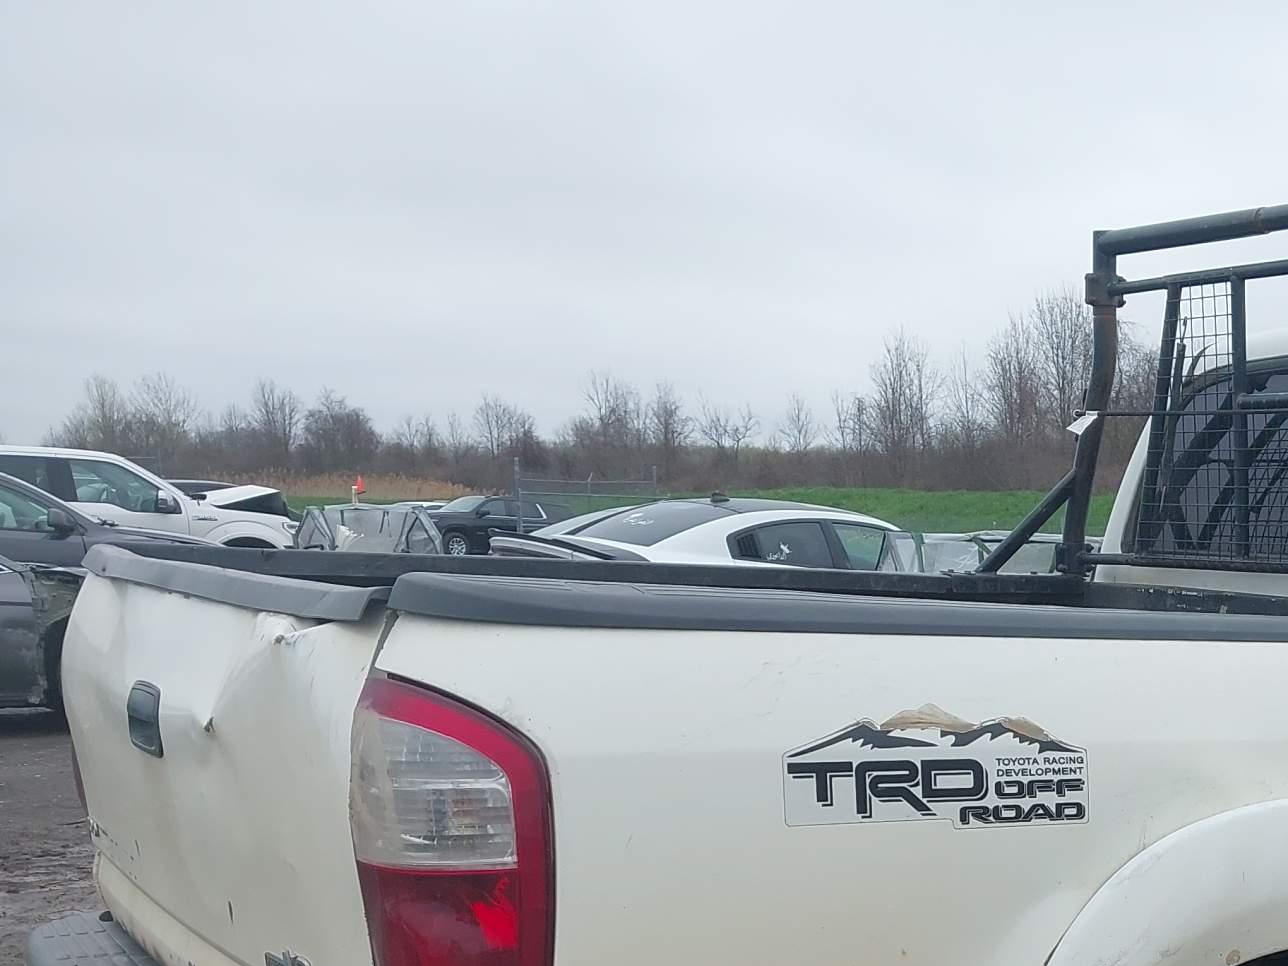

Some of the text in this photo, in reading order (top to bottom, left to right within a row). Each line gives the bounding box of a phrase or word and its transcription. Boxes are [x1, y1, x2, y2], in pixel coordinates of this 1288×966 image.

[995, 756, 1084, 767] TOYOTA RACING
[996, 766, 1084, 777] DEVELOPMENT
[787, 758, 989, 818] TRD
[994, 778, 1086, 799] OFF
[959, 802, 1086, 825] ROAD
